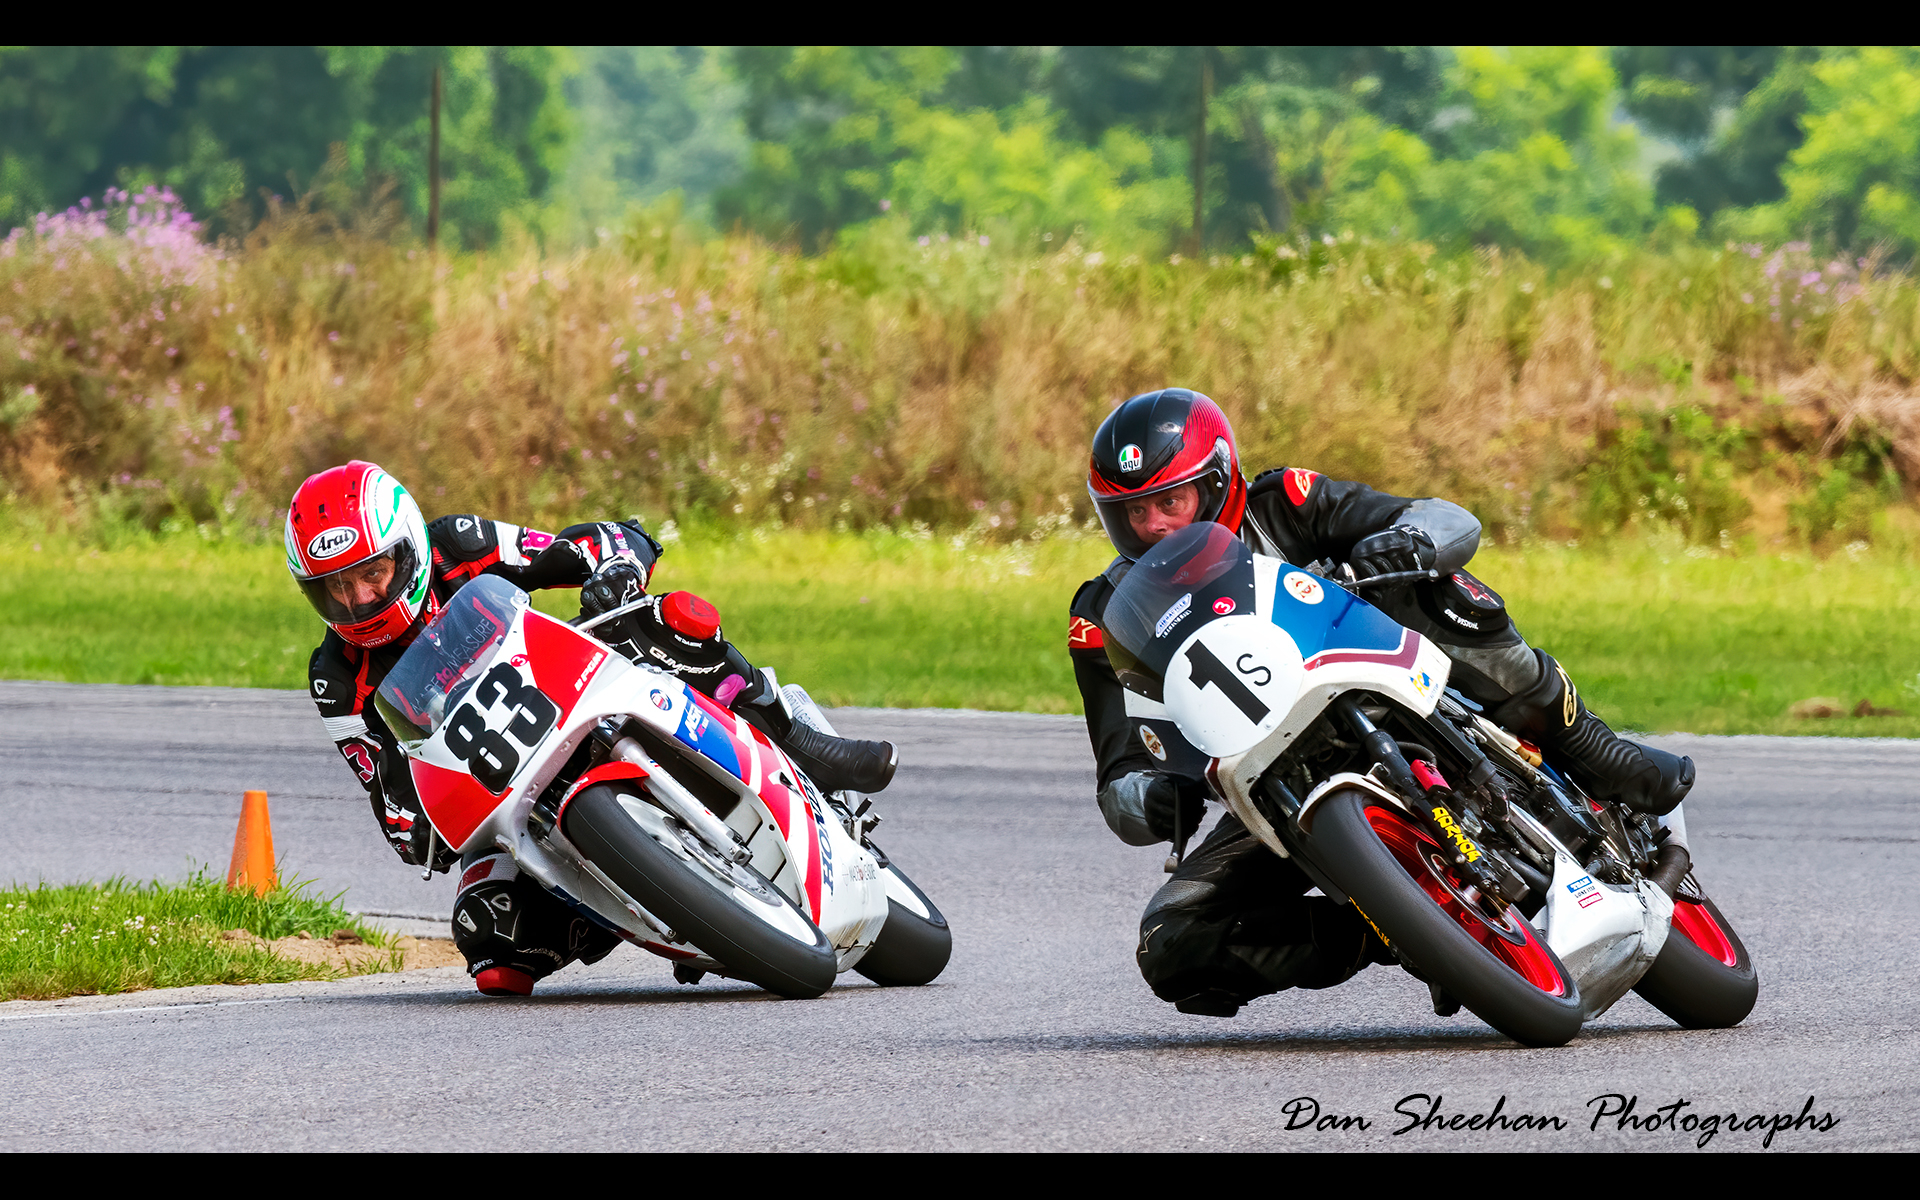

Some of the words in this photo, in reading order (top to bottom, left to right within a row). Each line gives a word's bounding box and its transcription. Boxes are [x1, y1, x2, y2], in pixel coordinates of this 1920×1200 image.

[312, 529, 351, 556] Arai
[649, 646, 726, 675] GUMPERT
[444, 662, 557, 796] 83
[795, 767, 834, 897] HONDA
